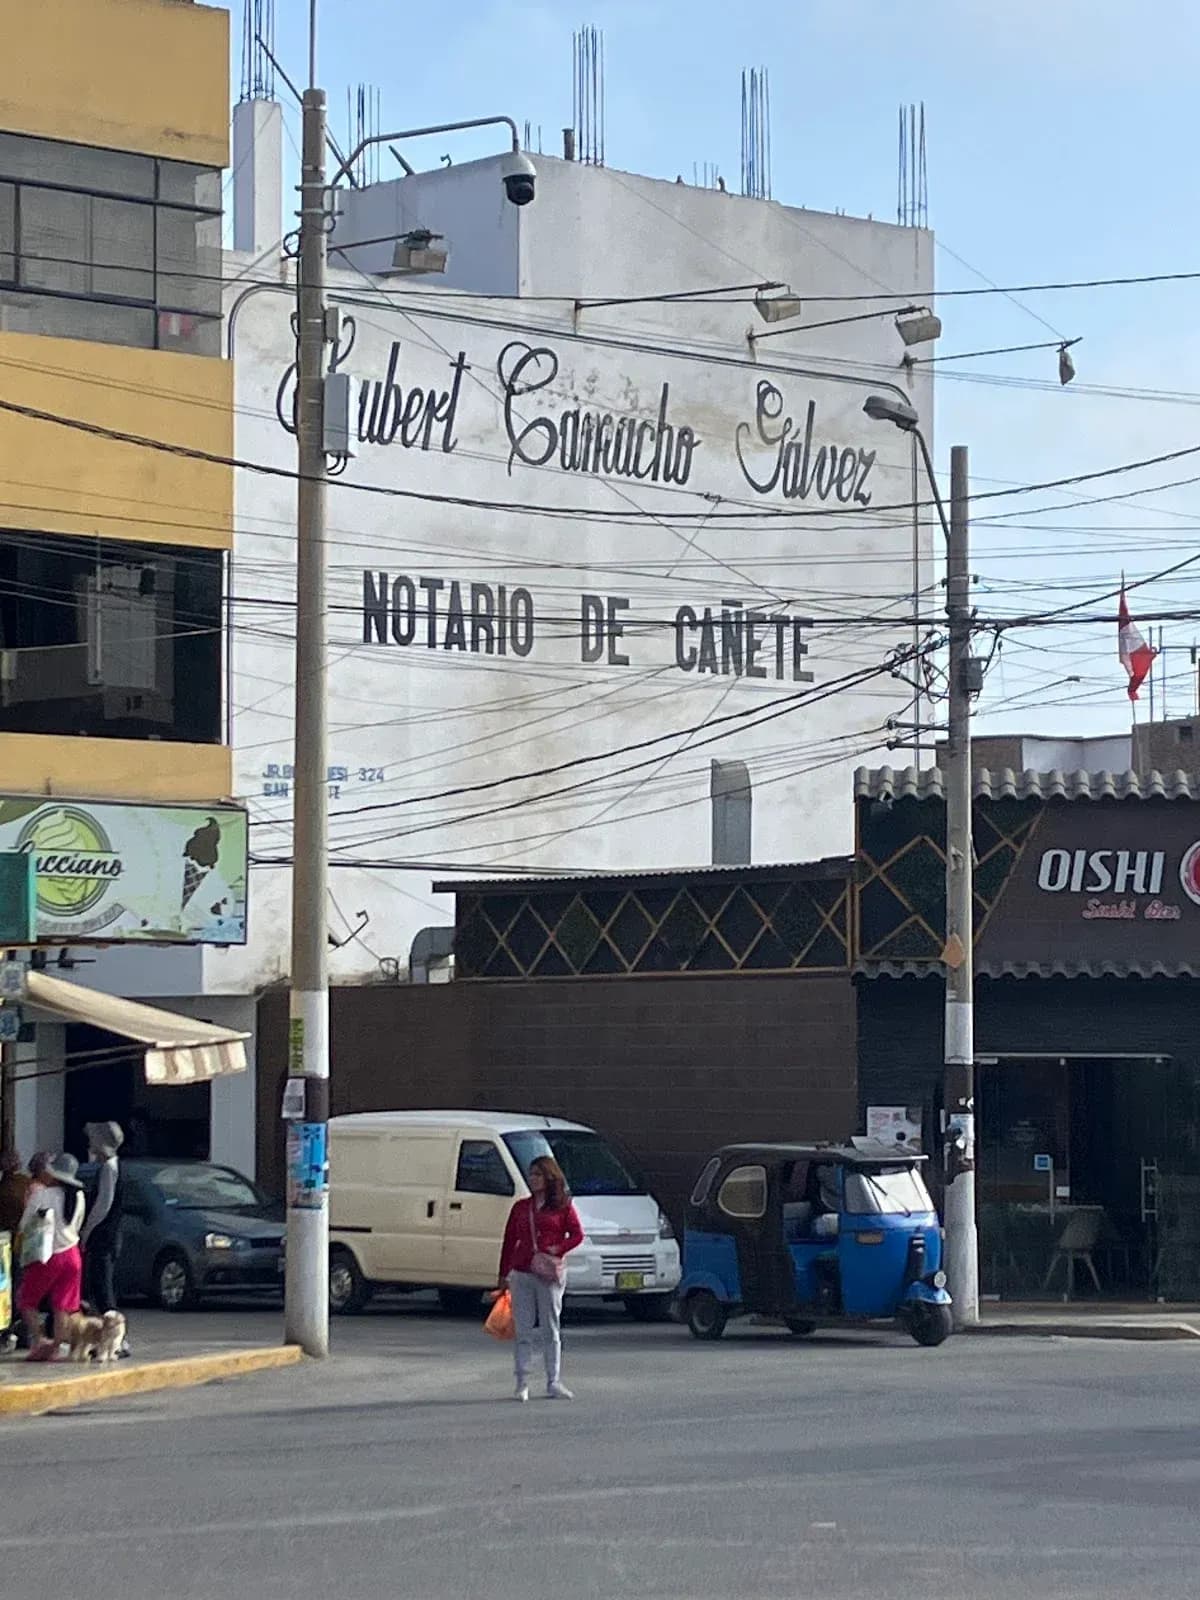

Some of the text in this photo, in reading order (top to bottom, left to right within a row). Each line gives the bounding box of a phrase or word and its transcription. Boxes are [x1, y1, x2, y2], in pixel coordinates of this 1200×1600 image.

[736, 380, 876, 505] Gálvez
[363, 570, 814, 683] NOTARIO DE CAÑETE
[359, 767, 384, 781] 324
[19, 840, 125, 876] ucciano
[1038, 849, 1165, 894] OISHI
